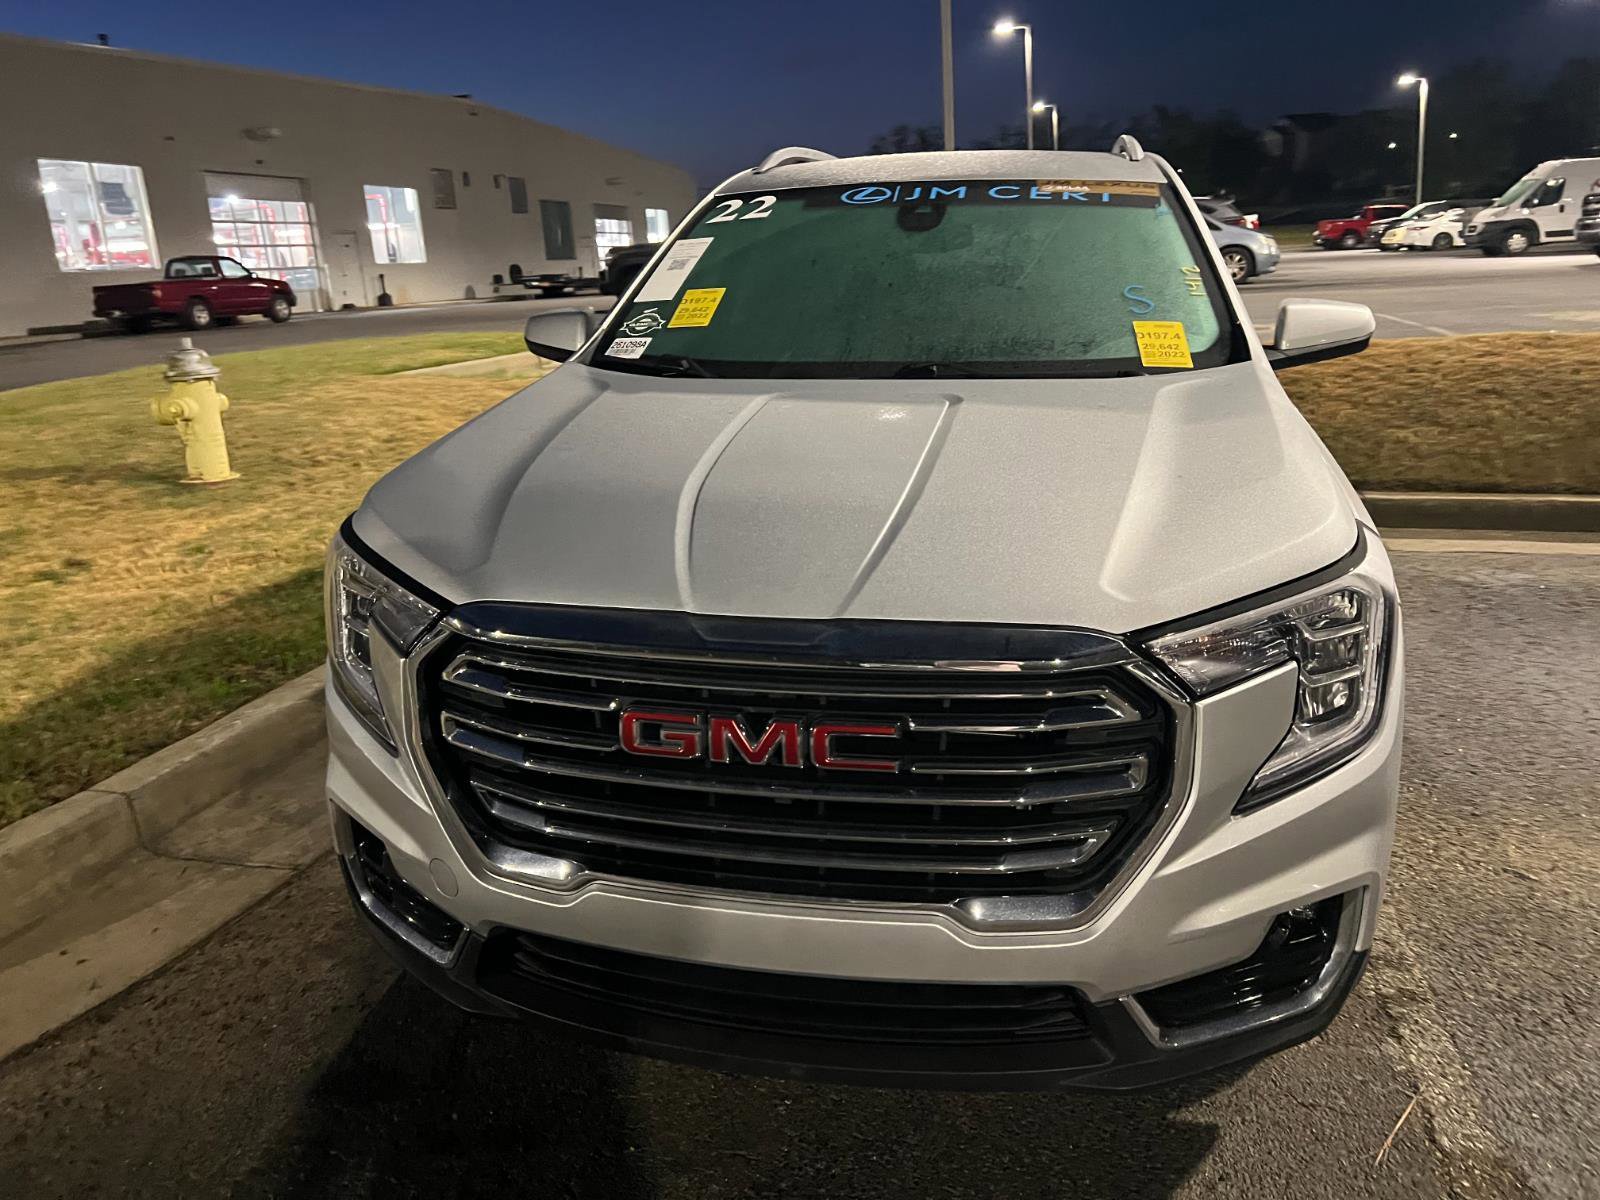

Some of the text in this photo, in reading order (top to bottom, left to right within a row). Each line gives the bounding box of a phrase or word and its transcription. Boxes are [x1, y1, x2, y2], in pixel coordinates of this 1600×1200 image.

[904, 186, 967, 200] JM
[705, 195, 777, 224] 22
[1123, 285, 1155, 314] S
[619, 711, 900, 774] GMC
